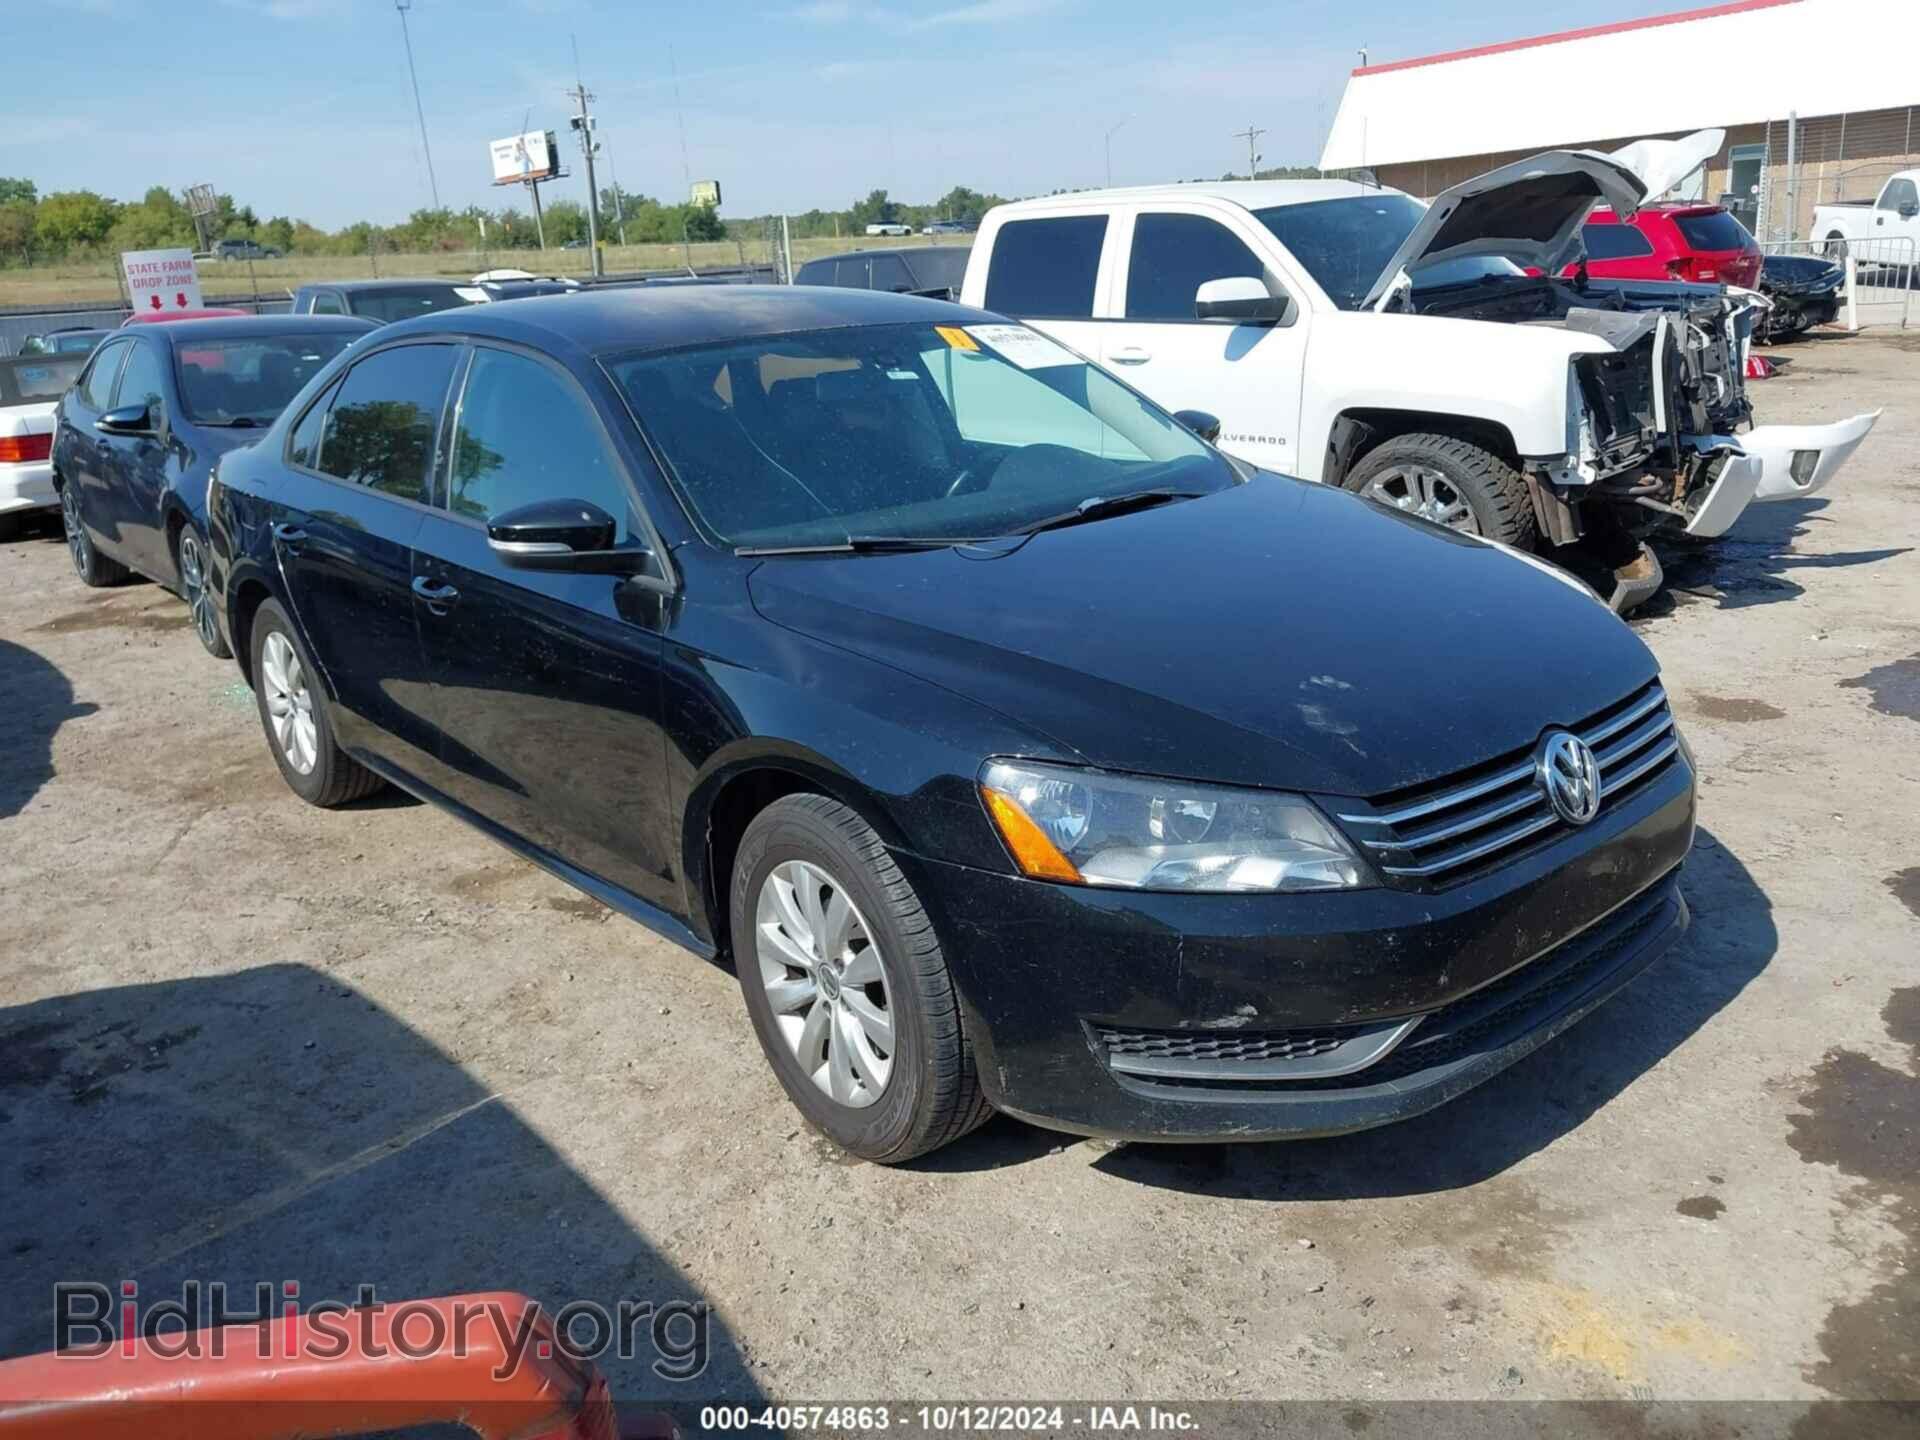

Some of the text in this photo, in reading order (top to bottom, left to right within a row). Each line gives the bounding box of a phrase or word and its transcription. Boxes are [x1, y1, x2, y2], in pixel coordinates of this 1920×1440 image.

[127, 260, 192, 275] STATE FARM
[132, 275, 192, 289] DROP ZONE
[1217, 433, 1287, 446] LVERADO
